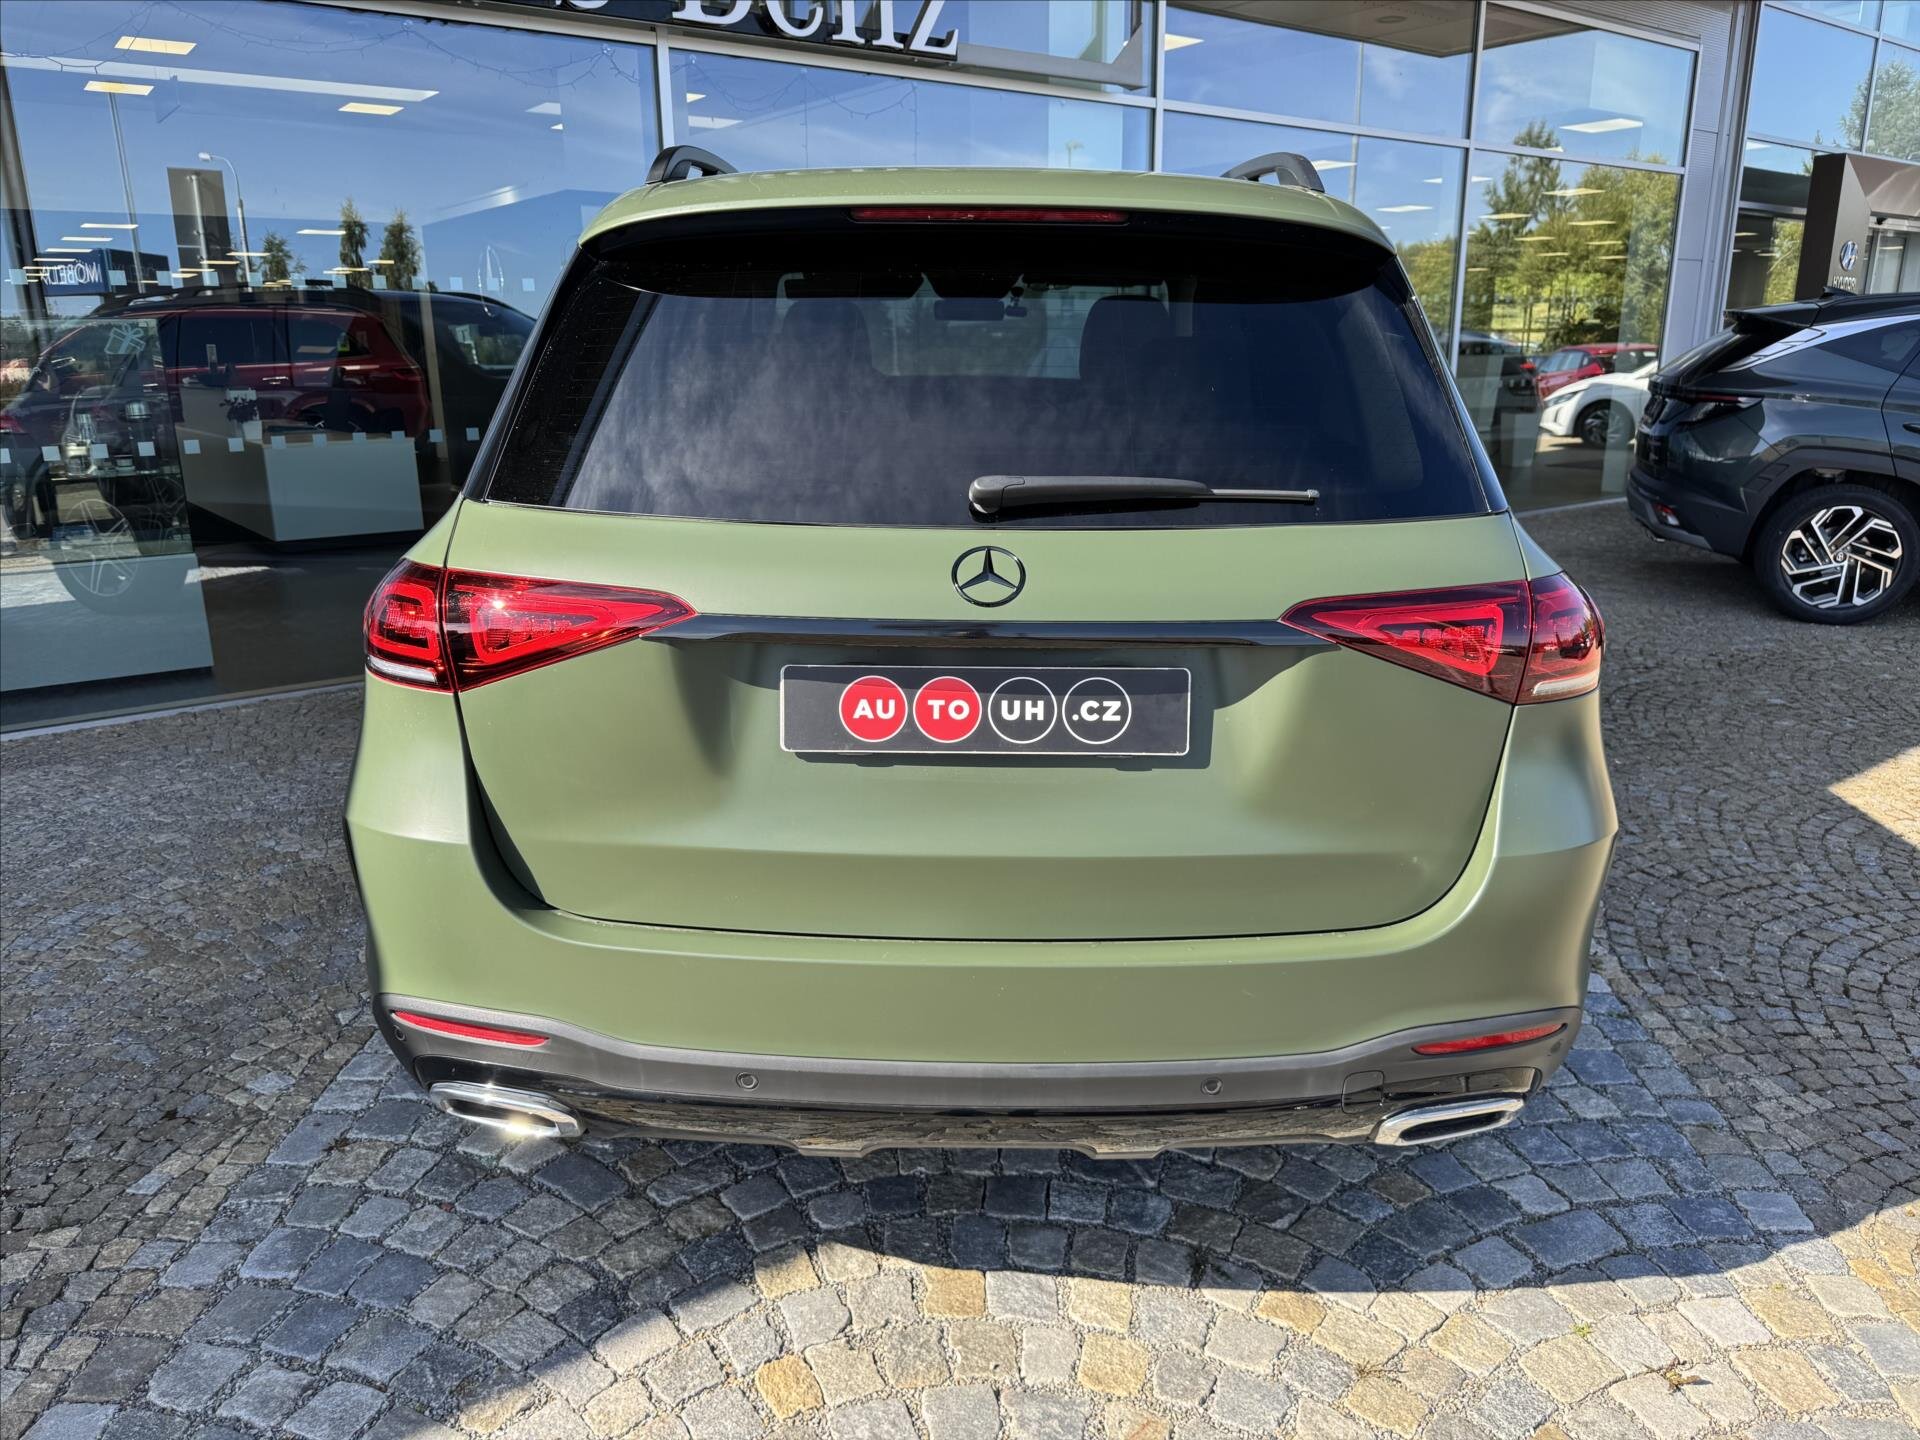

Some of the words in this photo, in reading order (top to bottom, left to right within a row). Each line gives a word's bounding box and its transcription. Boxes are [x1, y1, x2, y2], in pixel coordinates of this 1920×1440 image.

[672, 0, 959, 55] enz
[853, 699, 896, 719] AU
[928, 699, 970, 721] TO
[1001, 700, 1044, 721] UH
[1072, 701, 1121, 722] .CZ
